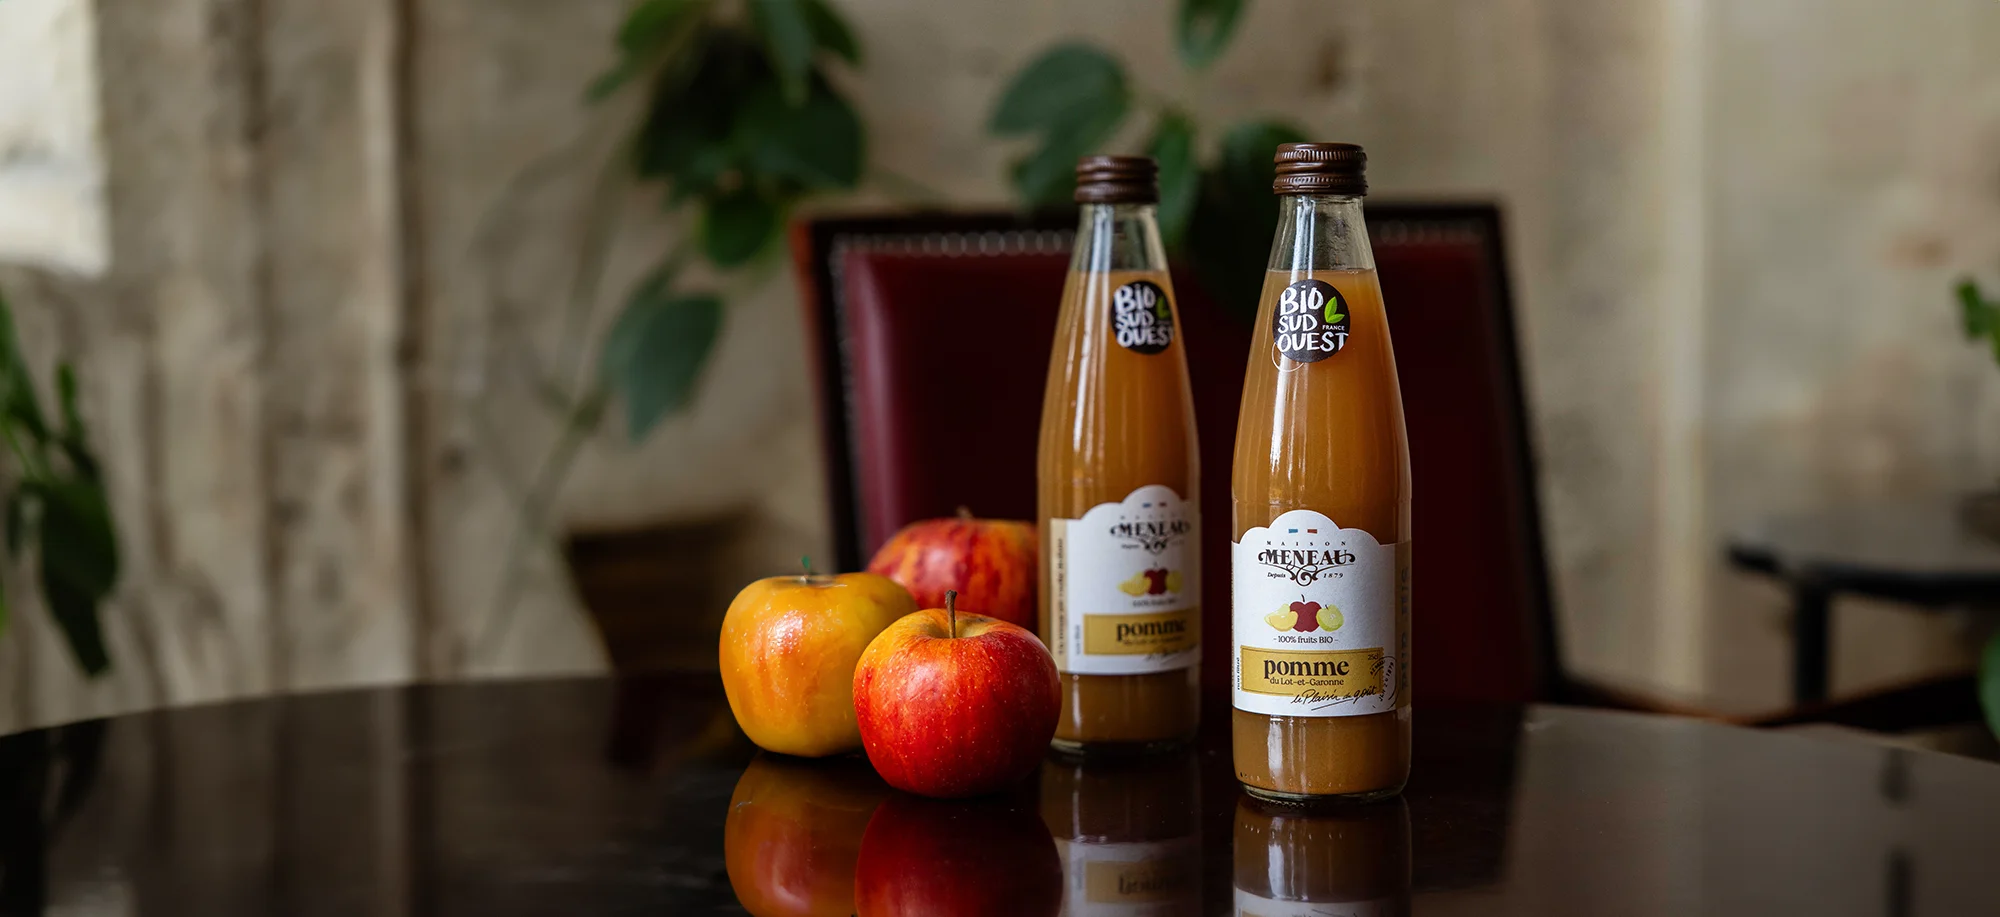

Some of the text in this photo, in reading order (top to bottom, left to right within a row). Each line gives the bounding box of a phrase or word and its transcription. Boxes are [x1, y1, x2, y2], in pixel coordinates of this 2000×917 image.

[1116, 309, 1155, 330] SUD
[1278, 314, 1318, 333] SUD
[1277, 332, 1349, 352] OUEST
[1264, 548, 1349, 566] MENEAU
[1278, 635, 1334, 644] 100% fruits BIO
[1263, 659, 1350, 679] pomme
[1269, 677, 1344, 687] du Lot-et-Garonne
[1301, 688, 1340, 705] Plaisir
